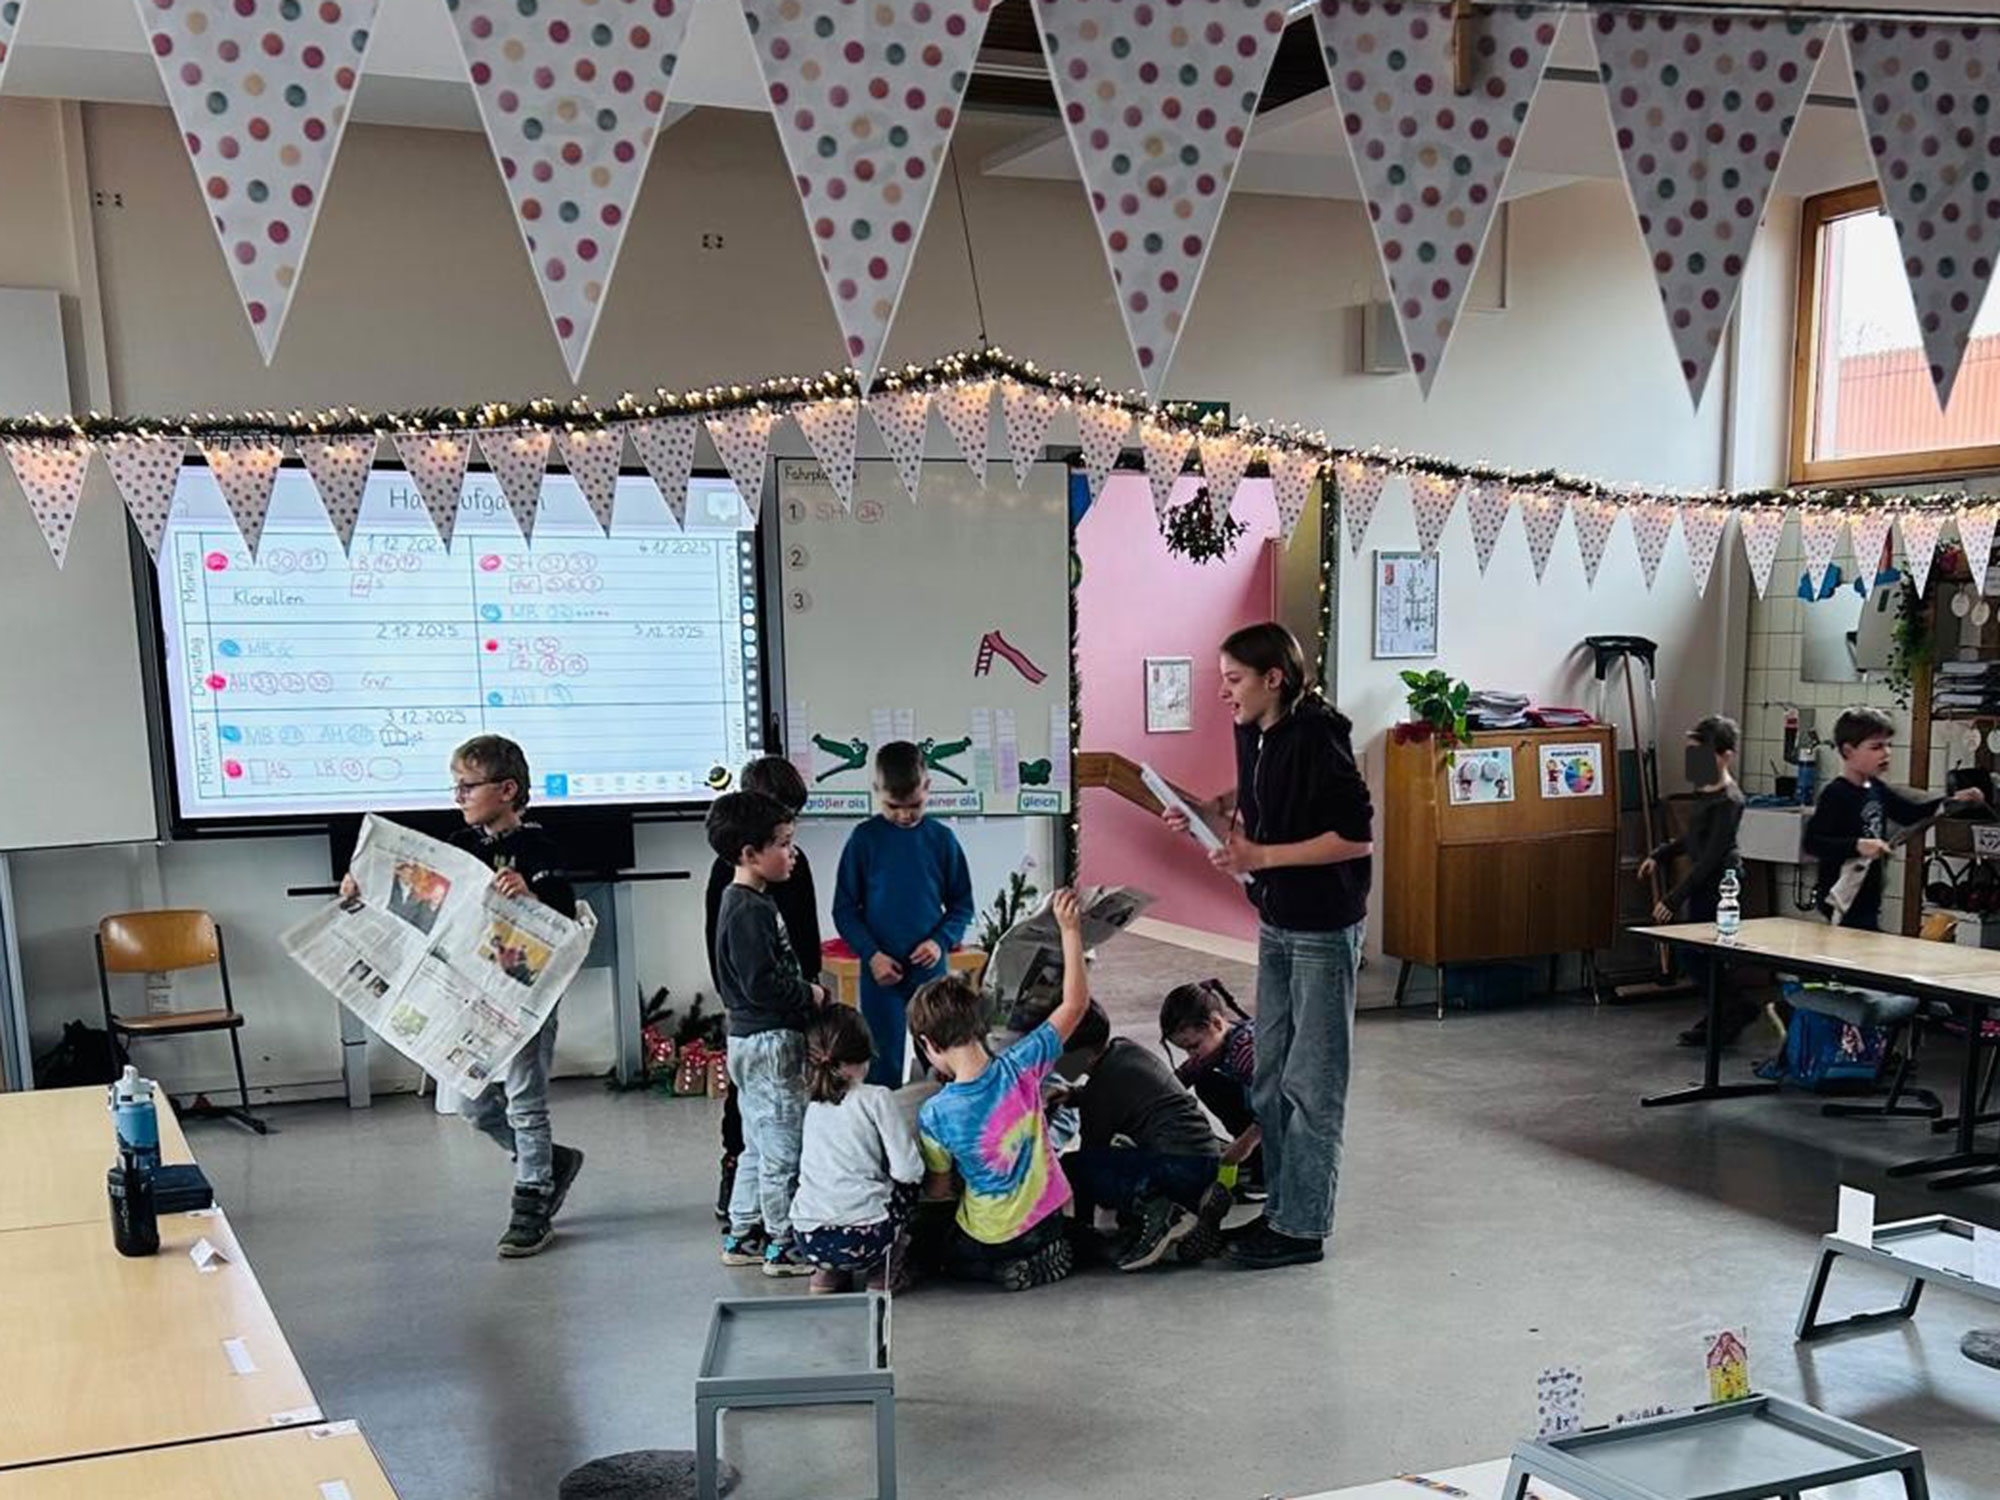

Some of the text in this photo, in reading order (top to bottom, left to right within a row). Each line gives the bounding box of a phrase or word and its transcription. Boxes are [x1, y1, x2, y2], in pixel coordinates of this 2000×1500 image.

[785, 466, 830, 482] Fahrpla
[390, 488, 546, 516] Haufgan
[926, 796, 957, 808] einer
